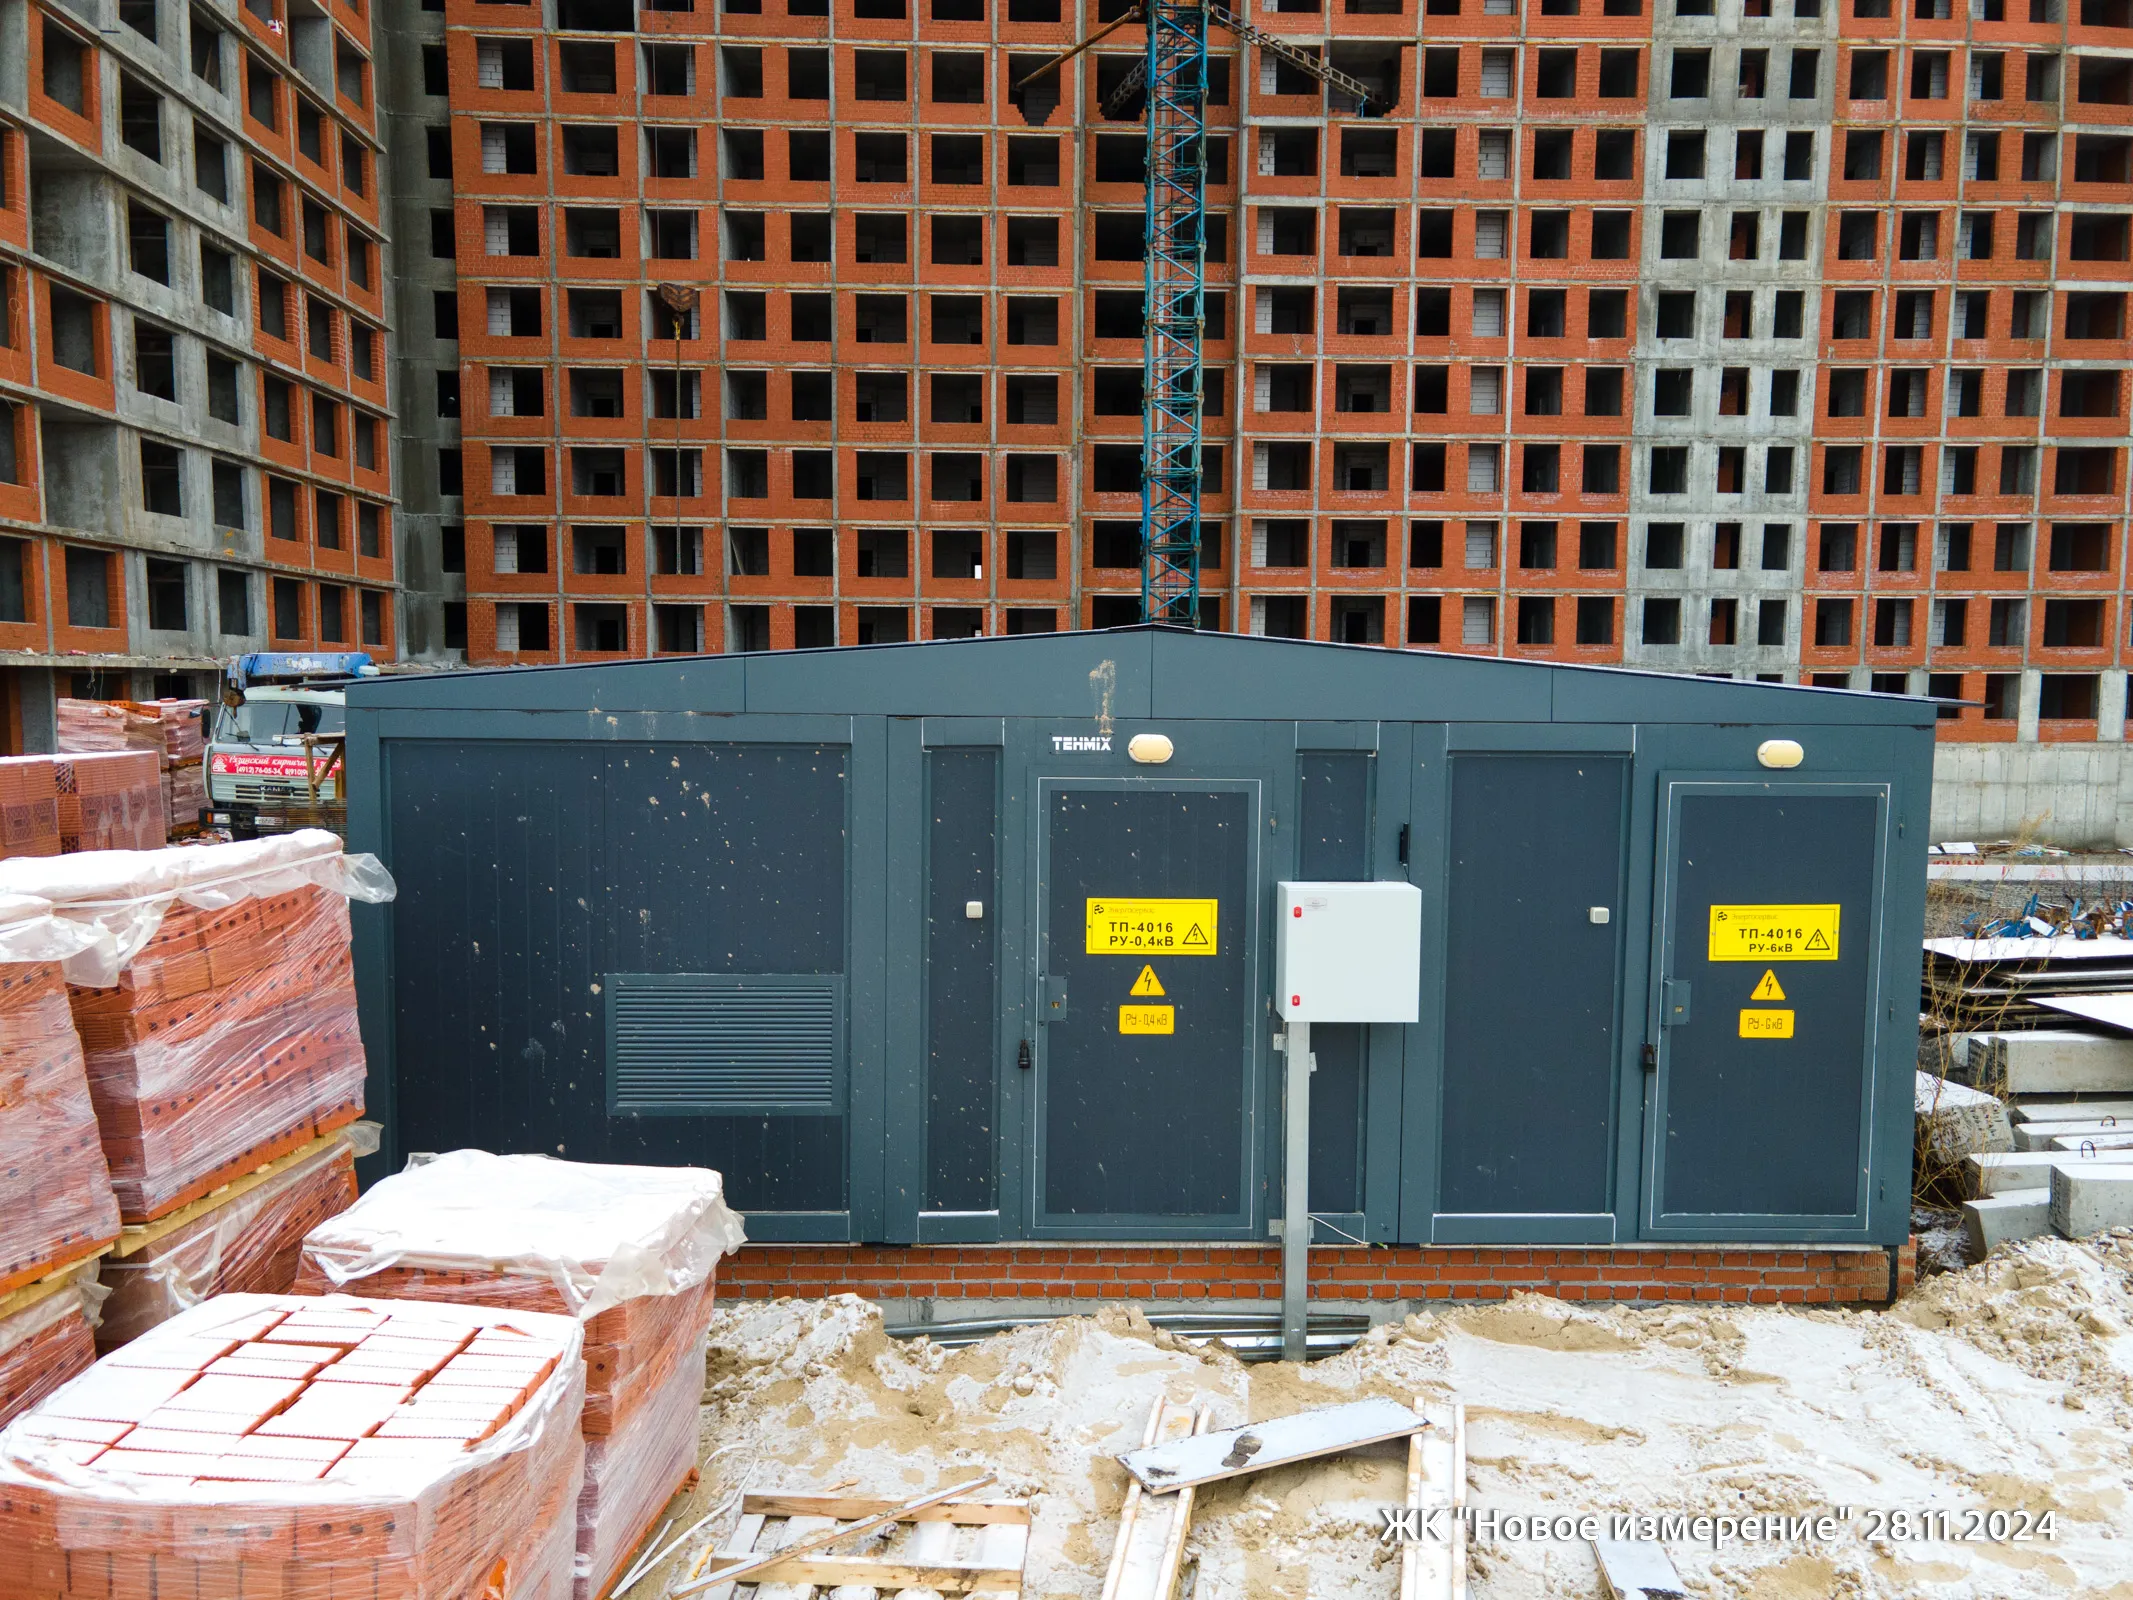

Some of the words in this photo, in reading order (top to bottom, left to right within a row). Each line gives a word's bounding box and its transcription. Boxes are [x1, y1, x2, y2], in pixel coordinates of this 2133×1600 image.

[1109, 922, 1173, 933] ТП-4016
[1739, 928, 1803, 939] ТП-4016
[1110, 936, 1174, 948] РУ-0,4кВ
[1749, 943, 1793, 953] РУ-6кВ
